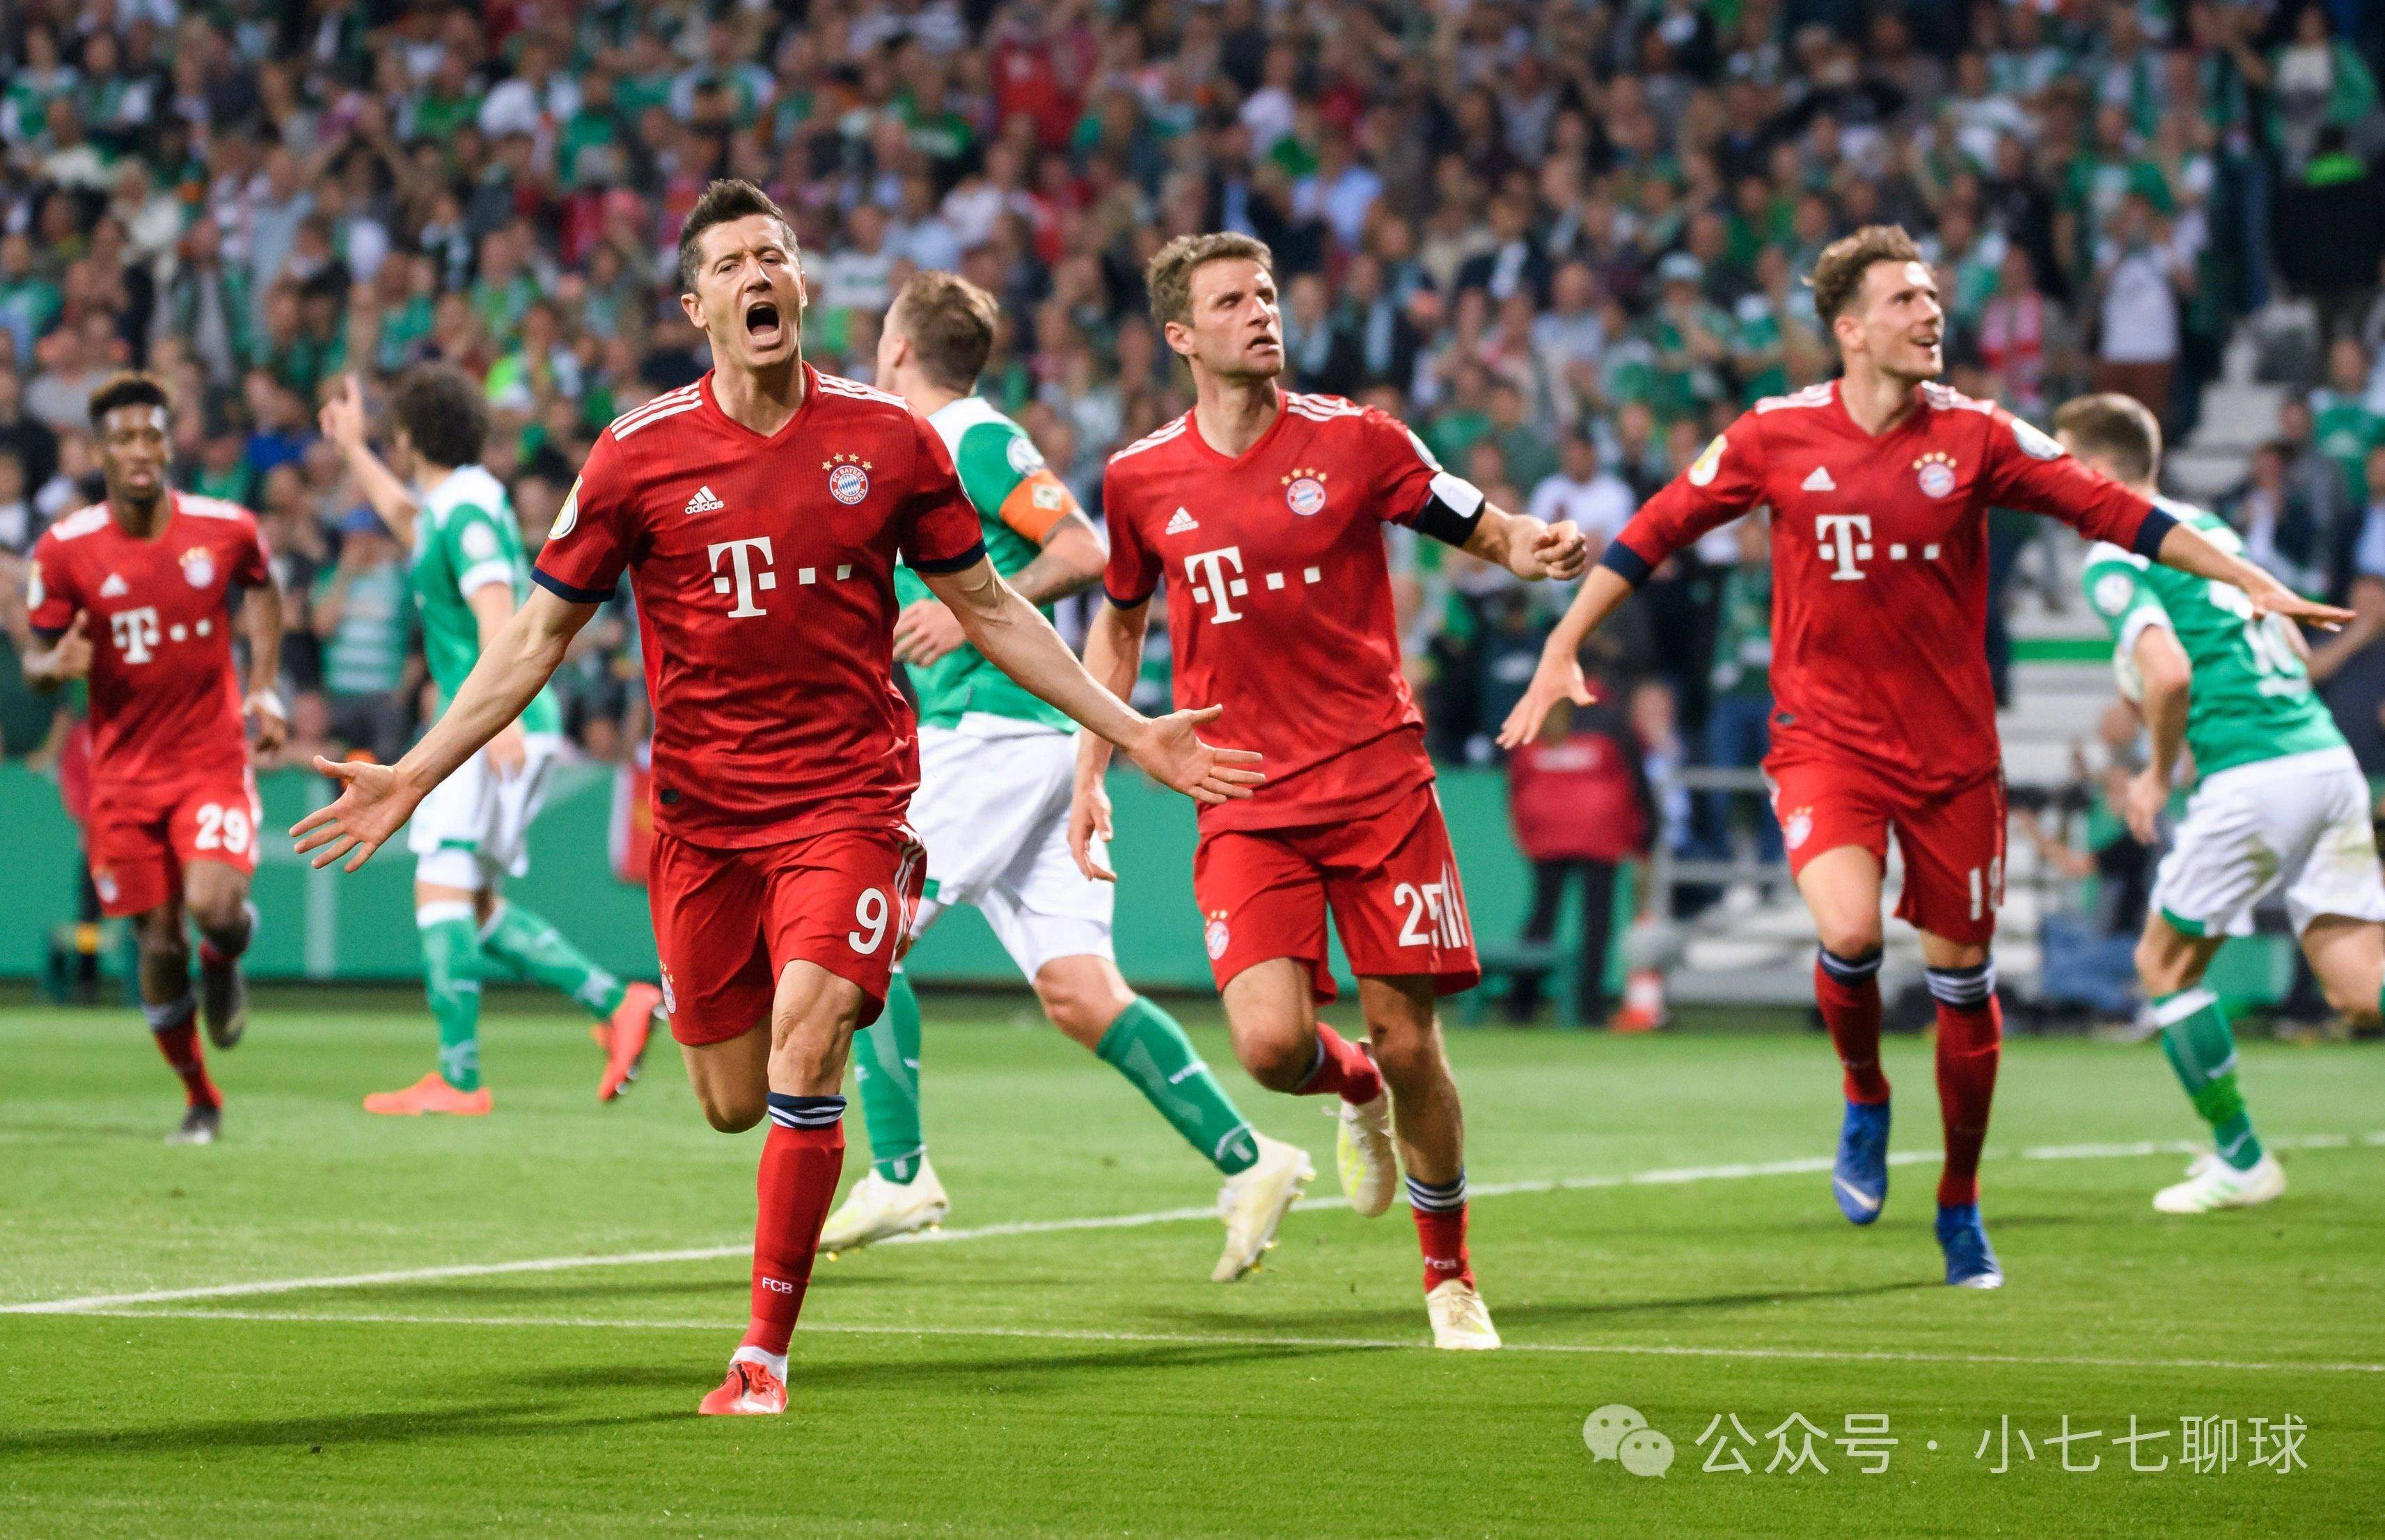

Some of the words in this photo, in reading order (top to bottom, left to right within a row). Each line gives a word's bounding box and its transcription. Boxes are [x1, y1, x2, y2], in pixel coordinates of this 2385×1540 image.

[838, 467, 865, 482] BAYERN
[684, 500, 725, 514] adidas
[195, 802, 250, 854] 29
[848, 887, 888, 955] 9
[762, 1276, 793, 1294] FCB
